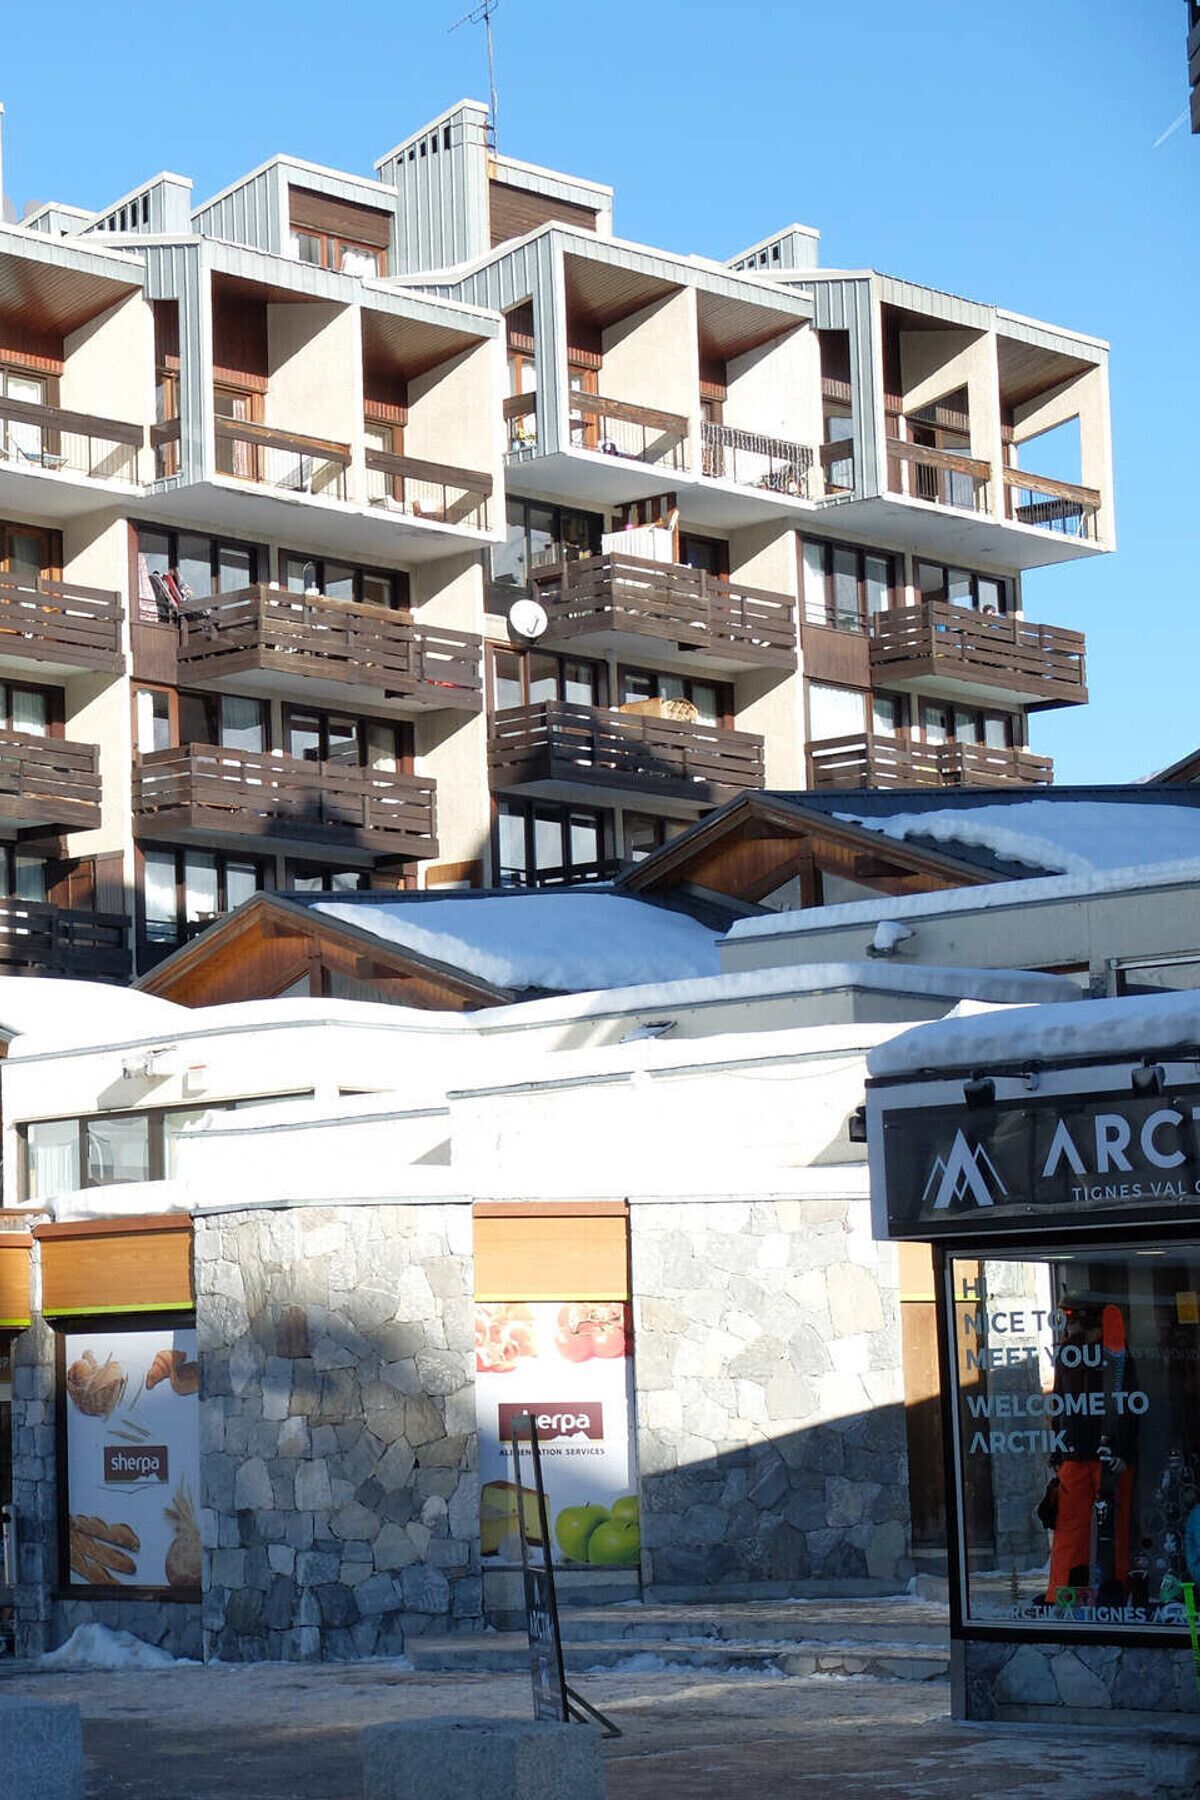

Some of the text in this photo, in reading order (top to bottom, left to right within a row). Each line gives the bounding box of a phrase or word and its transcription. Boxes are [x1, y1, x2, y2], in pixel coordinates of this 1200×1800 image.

[1072, 1183, 1142, 1201] TIGNES
[1150, 1180, 1187, 1197] VAL
[964, 1309, 1067, 1335] NICE TO
[966, 1346, 1037, 1371] MEET
[967, 1391, 1150, 1419] WELCOME TO
[111, 1452, 160, 1474] sherpa
[565, 1448, 606, 1456] SERVICES
[1083, 1606, 1146, 1623] TIGNES
